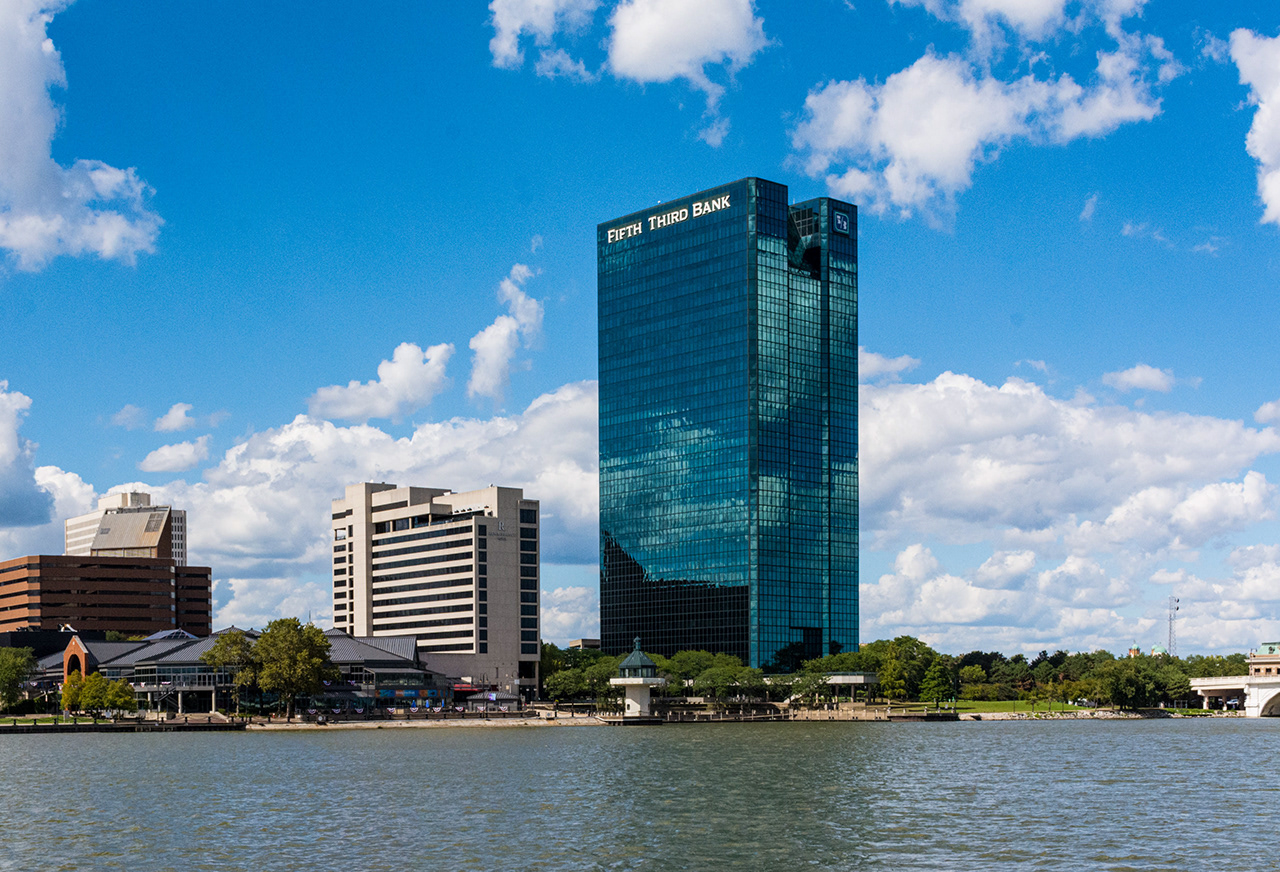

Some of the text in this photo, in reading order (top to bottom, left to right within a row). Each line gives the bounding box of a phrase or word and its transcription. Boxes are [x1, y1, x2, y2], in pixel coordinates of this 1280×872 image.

[607, 195, 731, 243] FIFTH THIRD BANK
